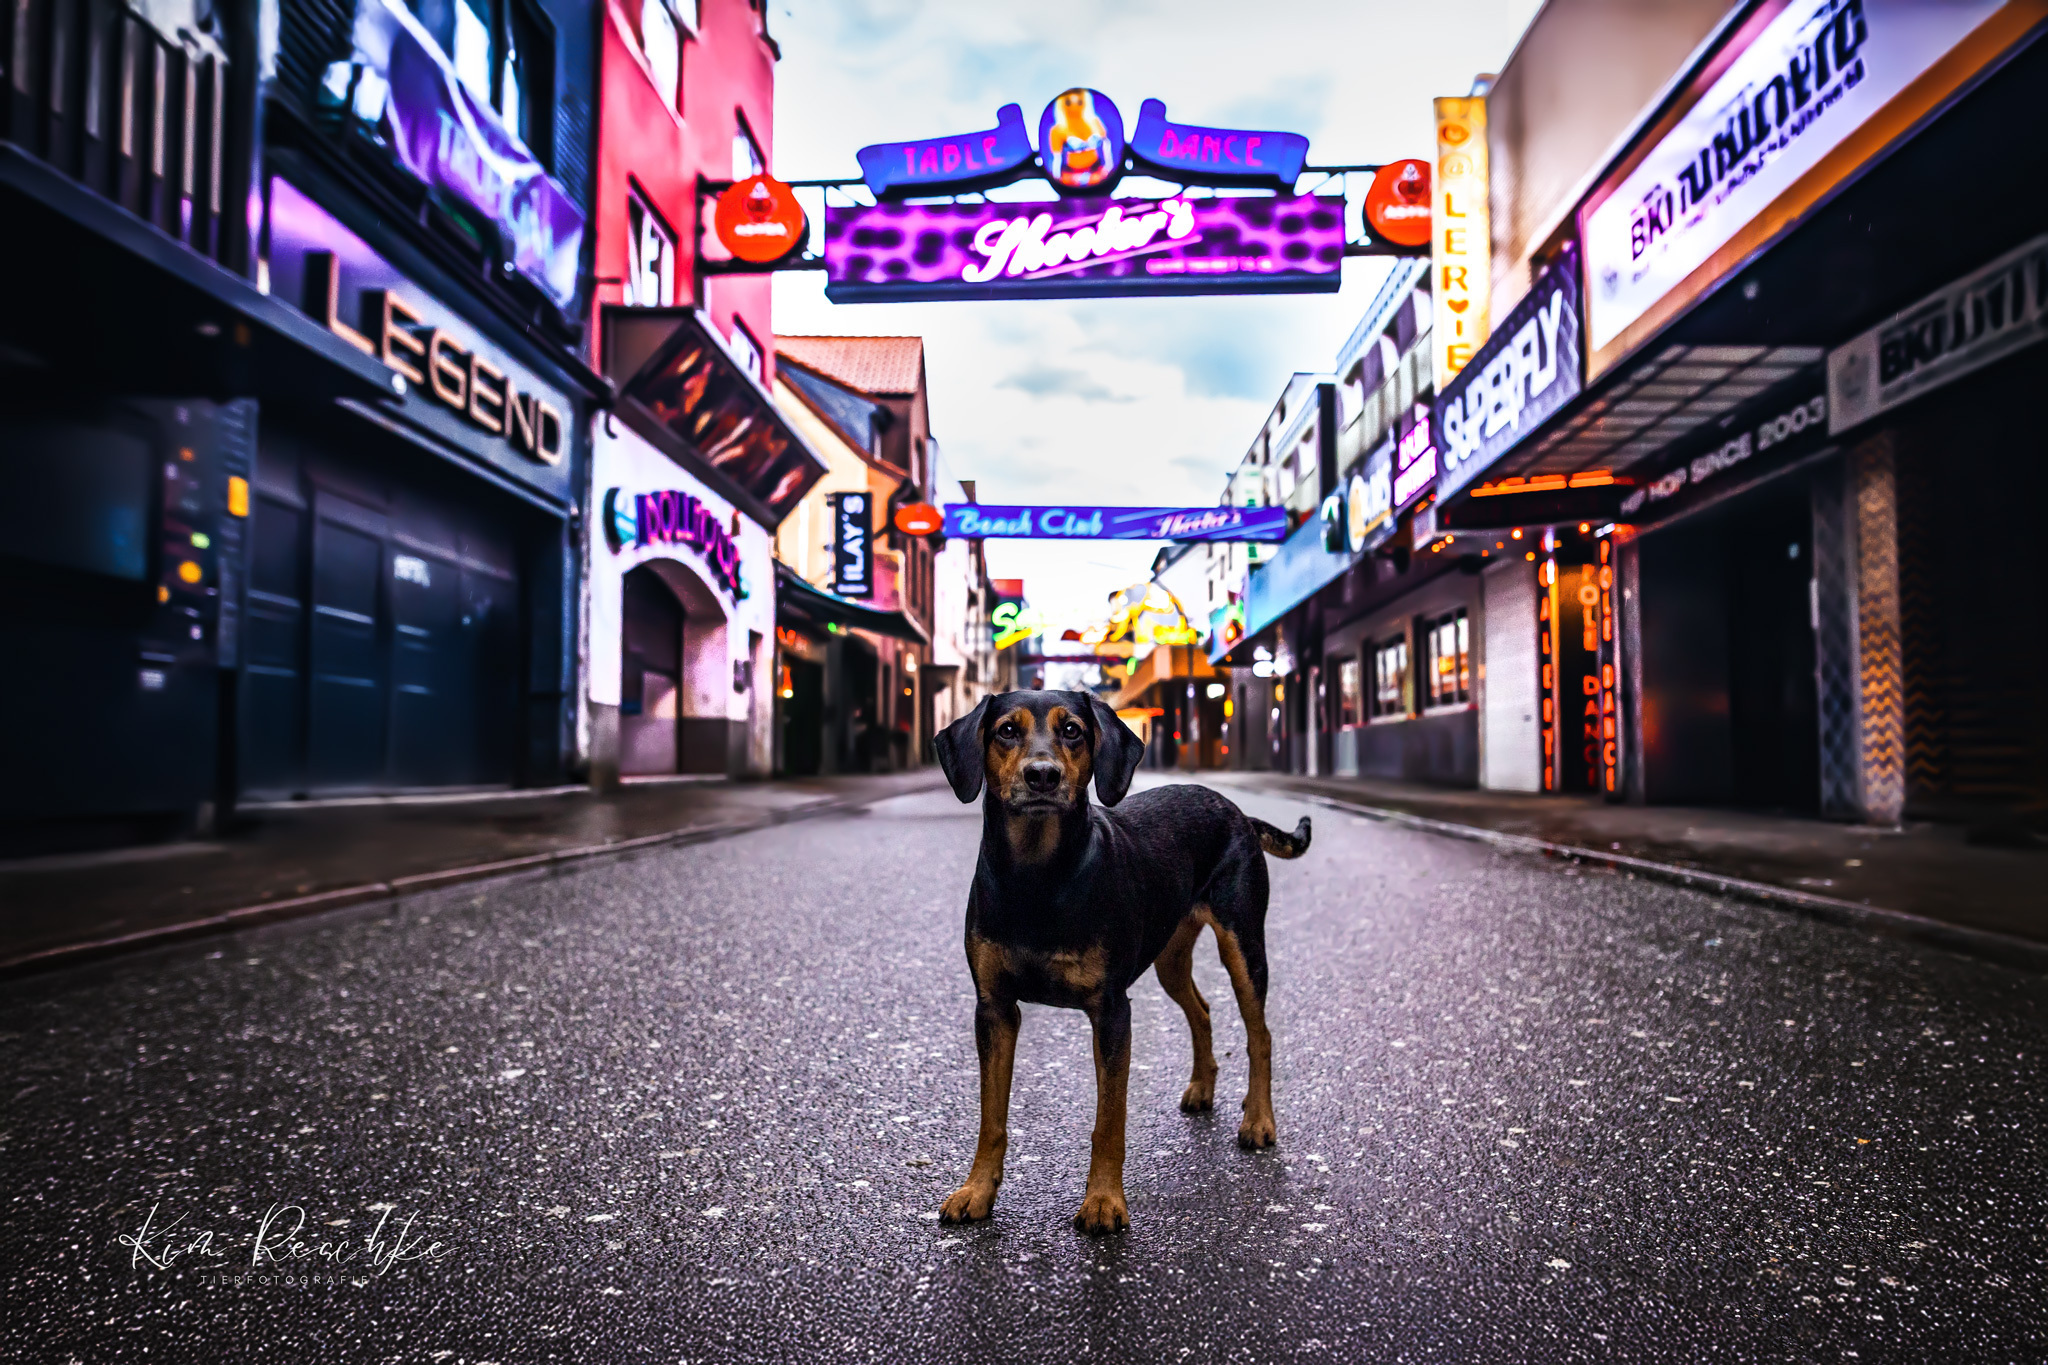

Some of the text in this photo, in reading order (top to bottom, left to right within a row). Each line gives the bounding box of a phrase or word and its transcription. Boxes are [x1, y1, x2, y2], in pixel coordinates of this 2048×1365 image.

[1158, 129, 1264, 167] DANCE
[962, 198, 1195, 283] Shooter's
[325, 248, 562, 467] LEGEND
[1444, 288, 1563, 470] SUPERFLY
[1690, 432, 1753, 484] SINCE
[1758, 395, 1825, 451] 2003
[842, 495, 865, 581] ILAY'S
[954, 507, 1104, 537] Beach Club
